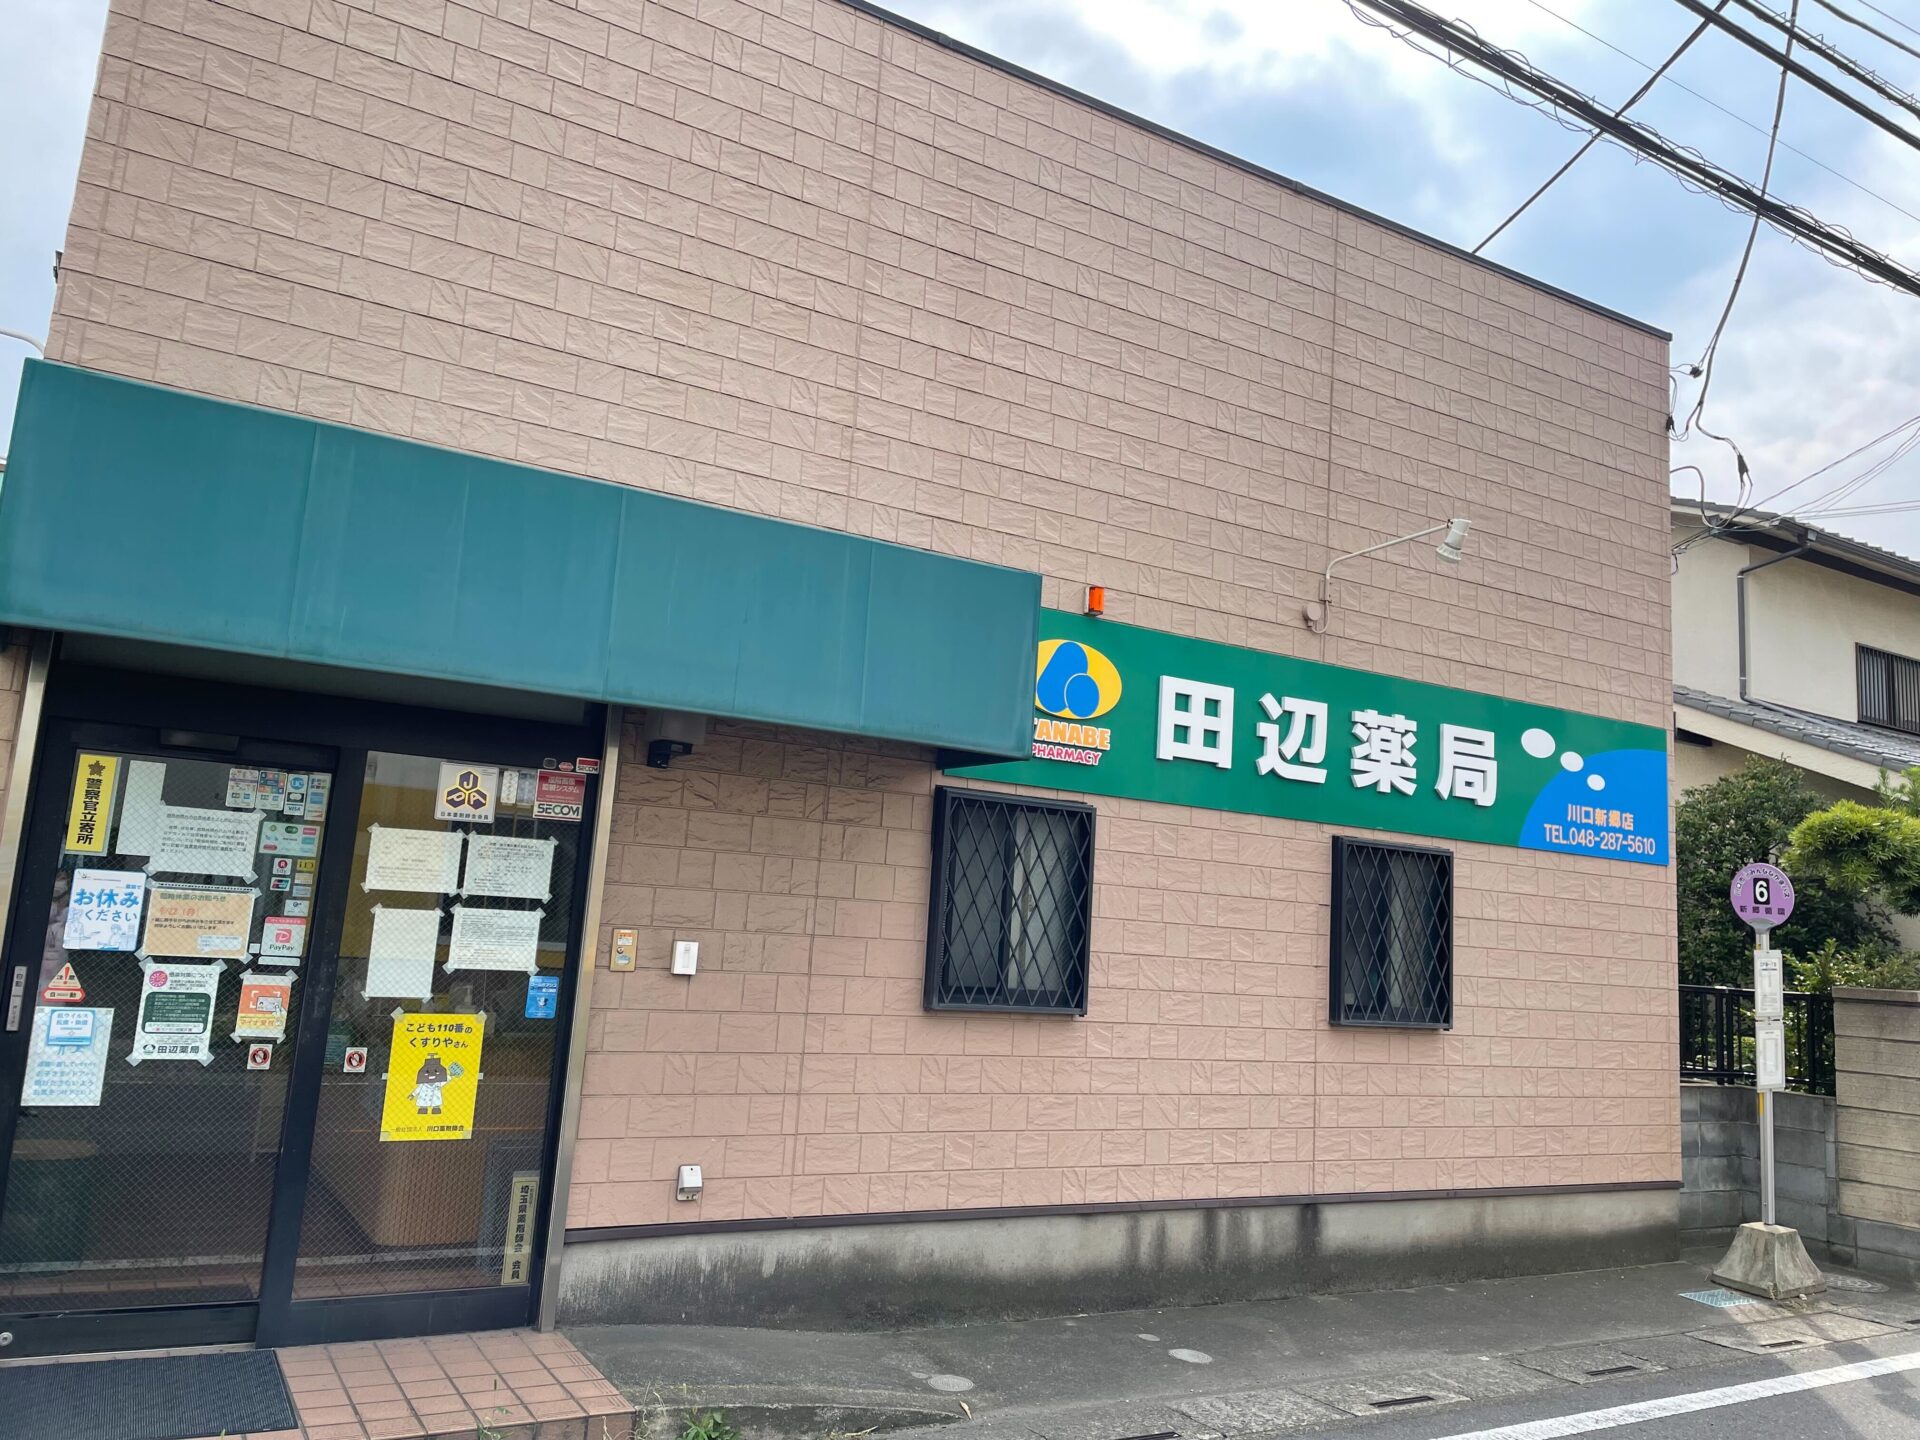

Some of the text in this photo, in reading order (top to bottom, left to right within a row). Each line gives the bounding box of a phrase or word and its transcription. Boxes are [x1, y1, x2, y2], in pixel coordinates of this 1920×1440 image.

[1034, 718, 1110, 750] ANABE
[1156, 674, 1498, 807] 田辺薬局
[76, 777, 103, 845] 警察官立寄所
[537, 803, 580, 817] SECOM
[1567, 803, 1634, 831] 川口新郷店
[1543, 823, 1656, 856] TEL.048-287-5610
[74, 888, 139, 908] お休み
[1755, 880, 1769, 902] 6
[85, 908, 137, 922] ください
[406, 1023, 473, 1034] こども110番の
[157, 1045, 200, 1054] 田辺薬局
[409, 1037, 469, 1048] くすりやさん
[511, 1261, 521, 1280] 会員
